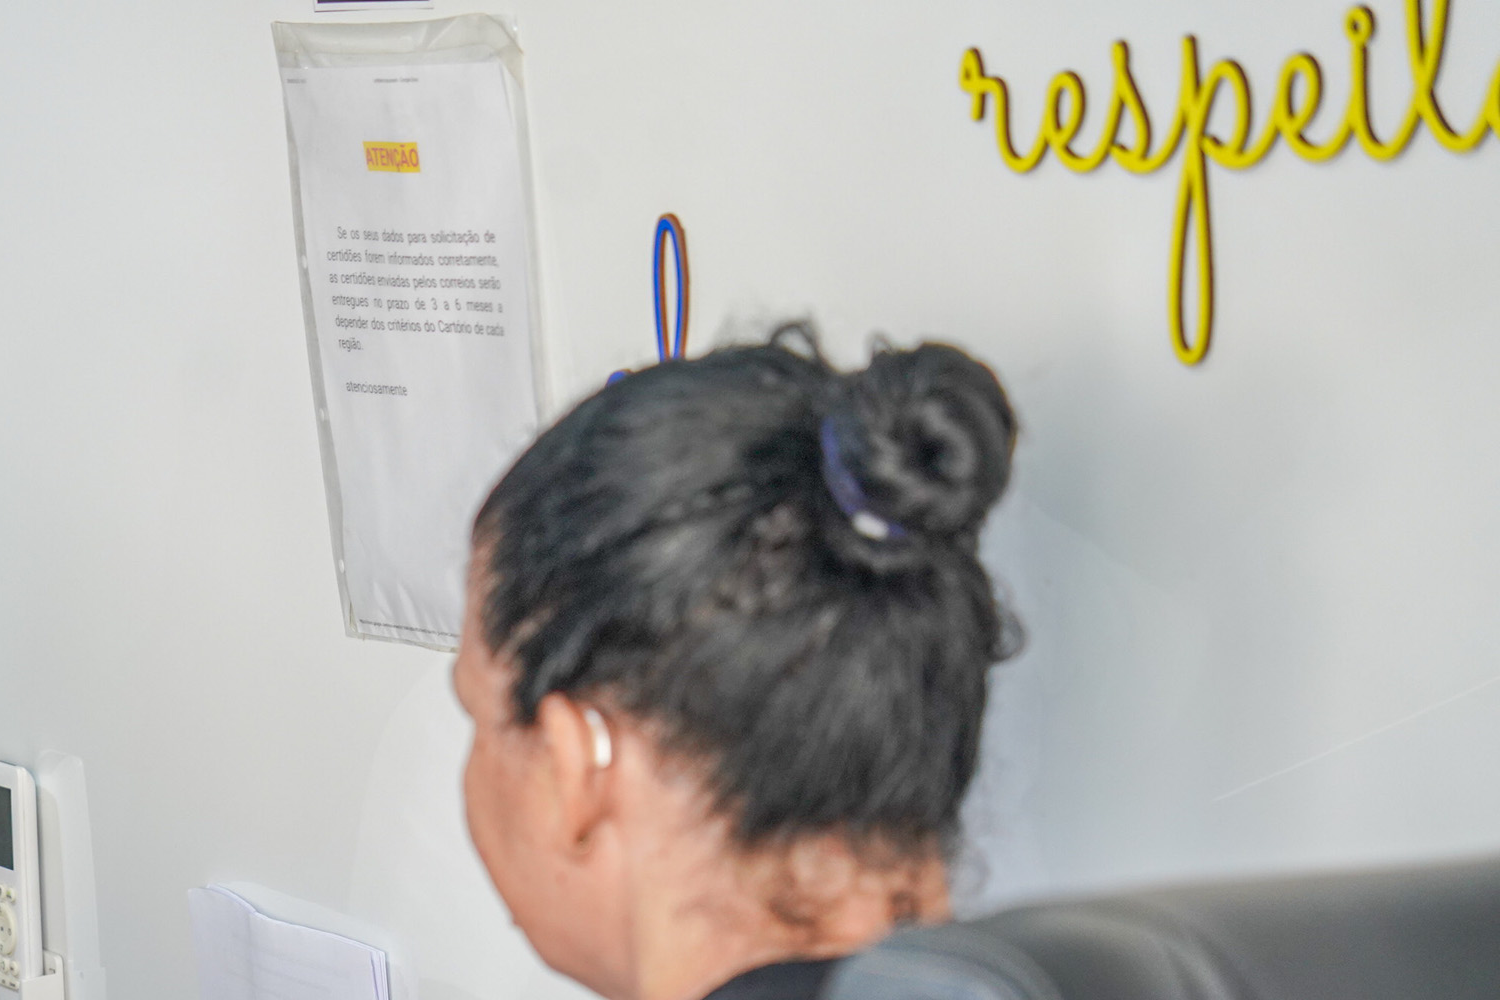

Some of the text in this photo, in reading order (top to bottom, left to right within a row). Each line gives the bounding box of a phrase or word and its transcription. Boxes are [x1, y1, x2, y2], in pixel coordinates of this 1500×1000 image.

[366, 144, 420, 172] ATENÇÃO
[959, 0, 1500, 365] respeit
[337, 226, 496, 246] Se os seus dados para solicitação de
[327, 249, 499, 268] certidões forem informados corretamente,
[329, 272, 501, 291] as certidões enviadas pelos correios serão
[332, 294, 369, 310] entregues
[374, 297, 383, 308] no
[387, 298, 409, 312] prazo
[415, 298, 426, 310] de
[431, 297, 438, 310] 3
[443, 301, 450, 311] a
[455, 298, 462, 311] 6
[466, 301, 494, 313] meses
[335, 315, 505, 337] depender dos critérios do Cartório de cada
[338, 337, 364, 352] região.
[346, 379, 408, 397] atenciosamente
